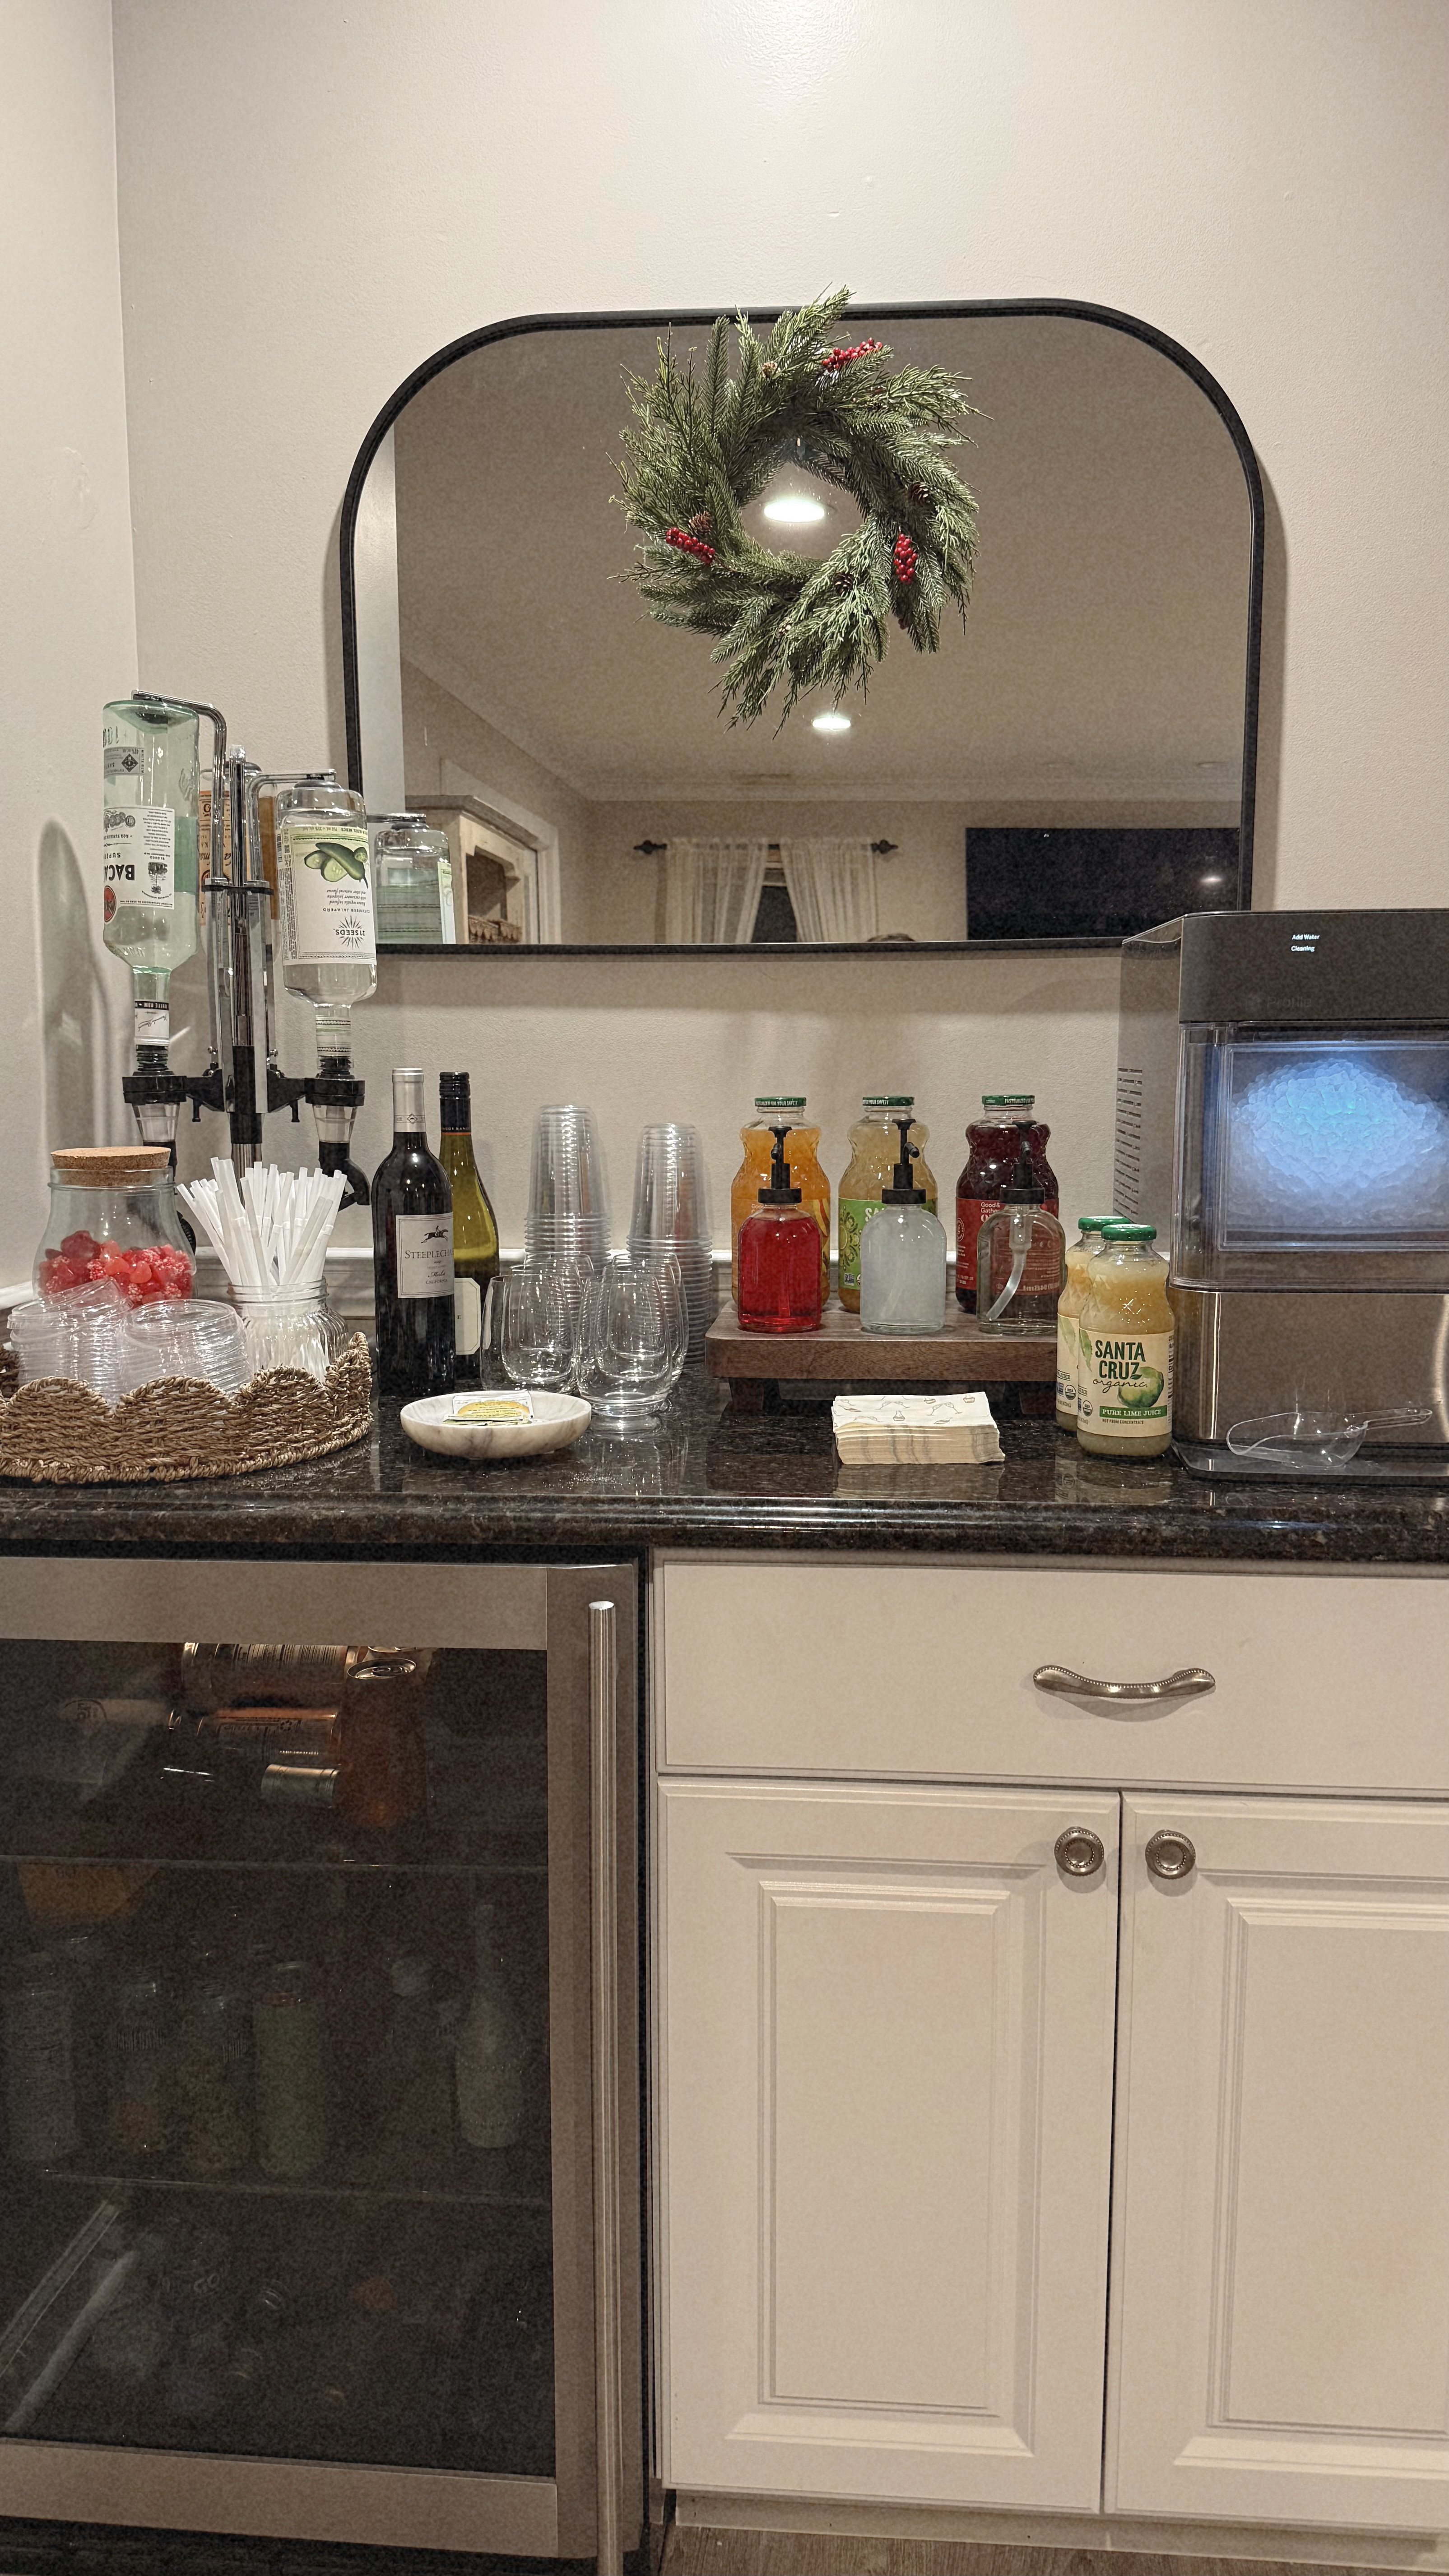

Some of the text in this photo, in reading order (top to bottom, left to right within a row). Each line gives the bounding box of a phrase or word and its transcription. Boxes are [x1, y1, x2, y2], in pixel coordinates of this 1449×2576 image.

[103, 864, 135, 882] BACA
[404, 1249, 453, 1259] STEEPLECHA
[1095, 1340, 1146, 1362] SANTA
[1099, 1360, 1142, 1380] CRUZ
[1093, 1379, 1146, 1393] organic
